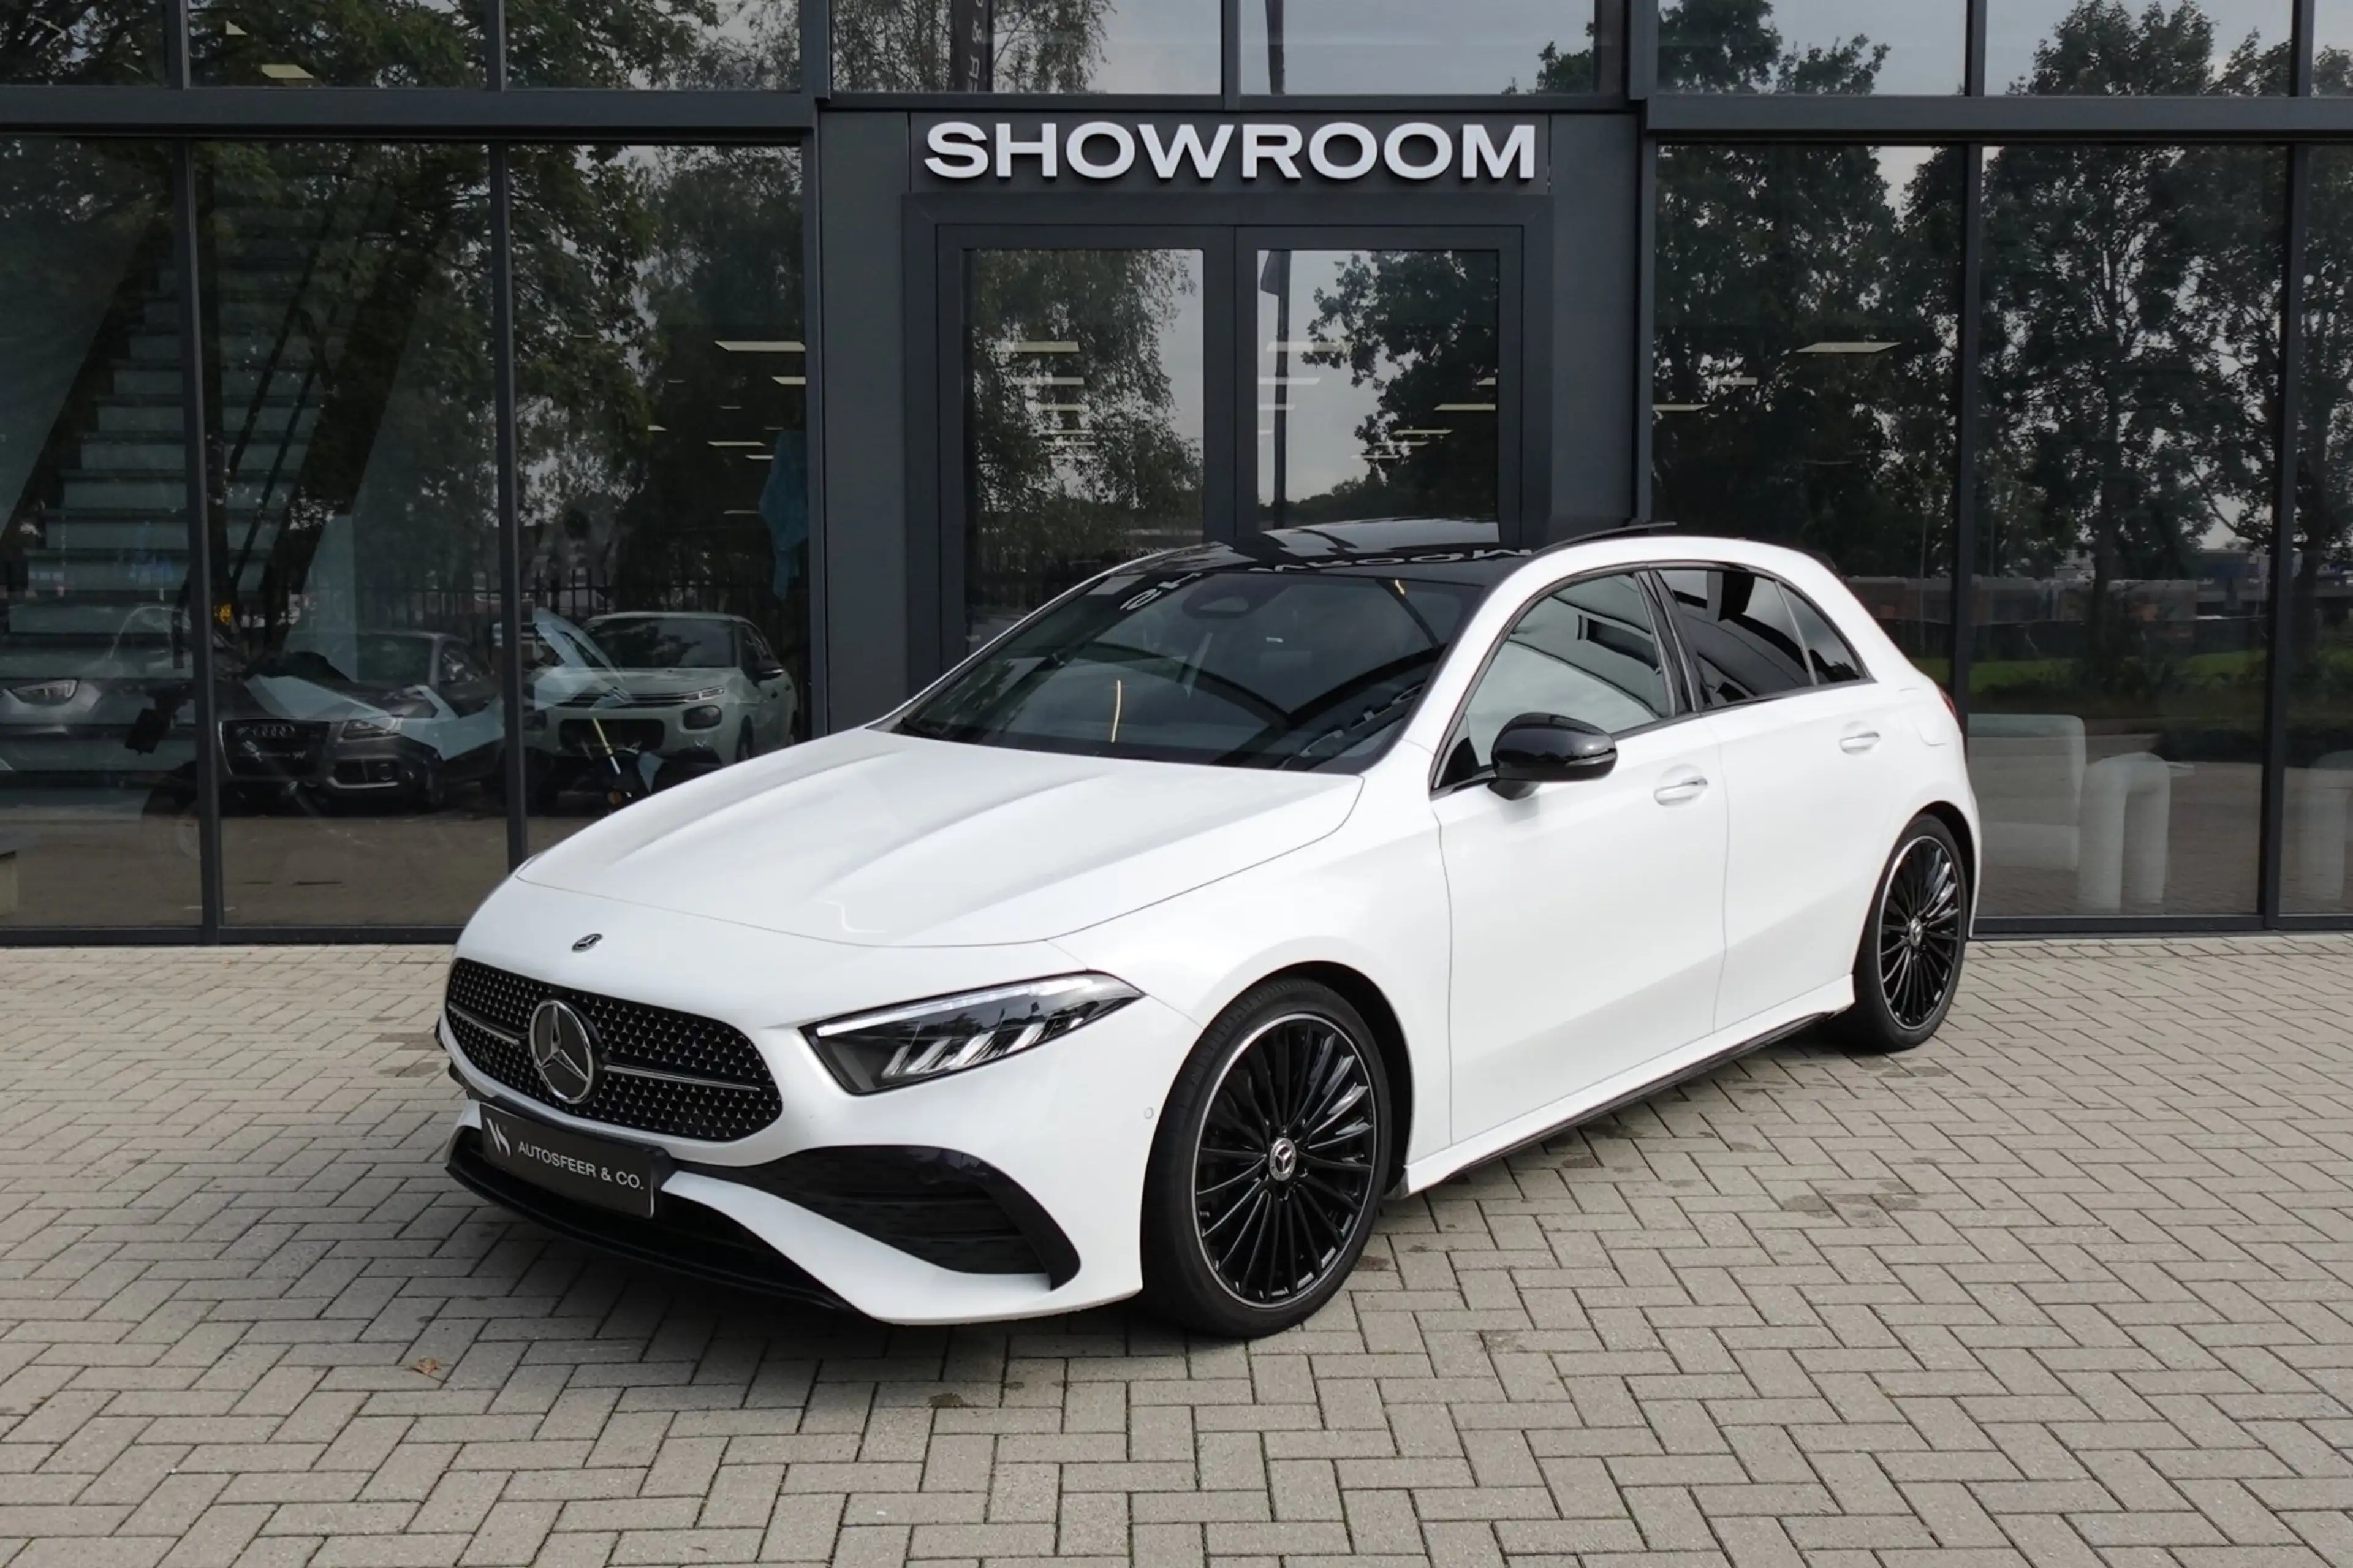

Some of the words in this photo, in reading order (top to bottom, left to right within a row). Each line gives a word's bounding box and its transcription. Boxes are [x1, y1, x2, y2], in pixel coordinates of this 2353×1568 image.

[925, 121, 1536, 179] SHOWROOM
[518, 1141, 597, 1178] AUTOSFEER
[601, 1167, 612, 1182] &
[616, 1171, 644, 1190] CO.
